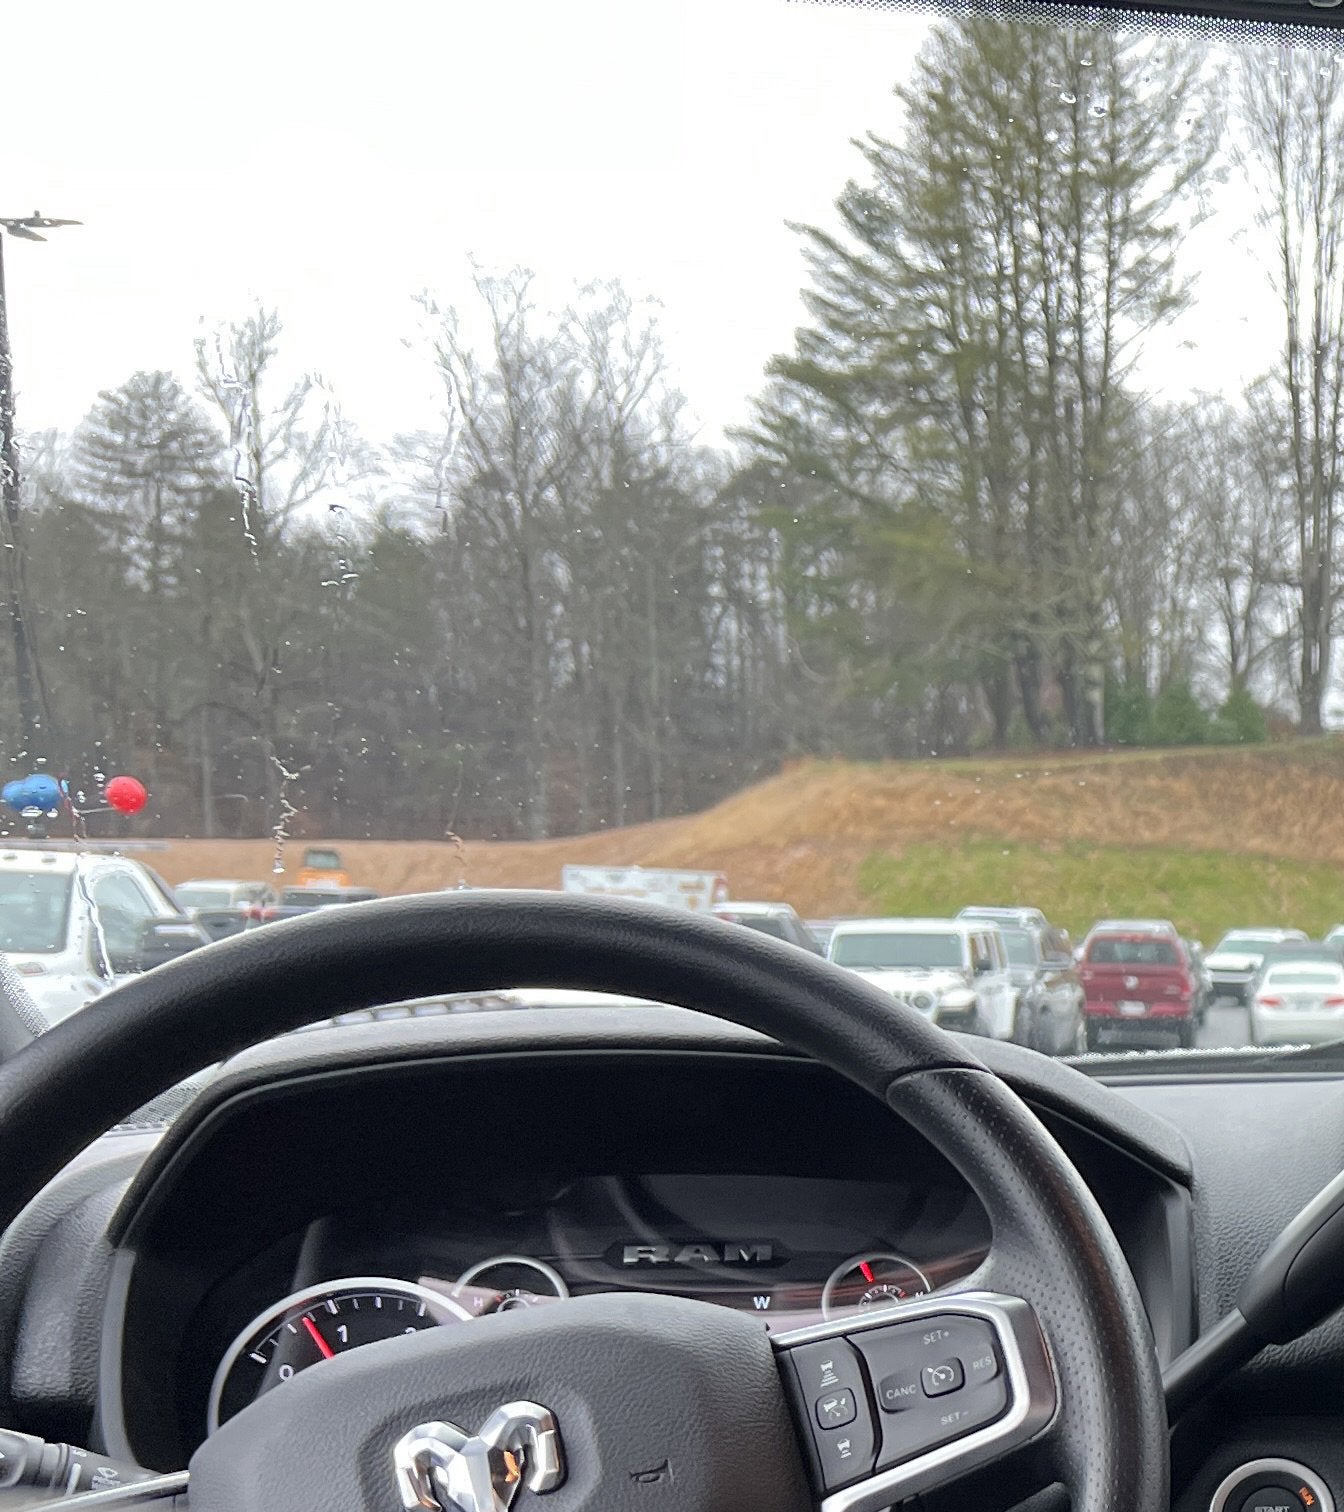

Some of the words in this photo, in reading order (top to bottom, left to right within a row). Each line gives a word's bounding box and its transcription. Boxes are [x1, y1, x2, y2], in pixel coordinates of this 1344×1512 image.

[623, 1243, 774, 1264] RAM
[753, 1296, 771, 1309] W
[337, 1324, 348, 1342] 1
[972, 1356, 992, 1370] RES
[886, 1384, 917, 1399] CANC
